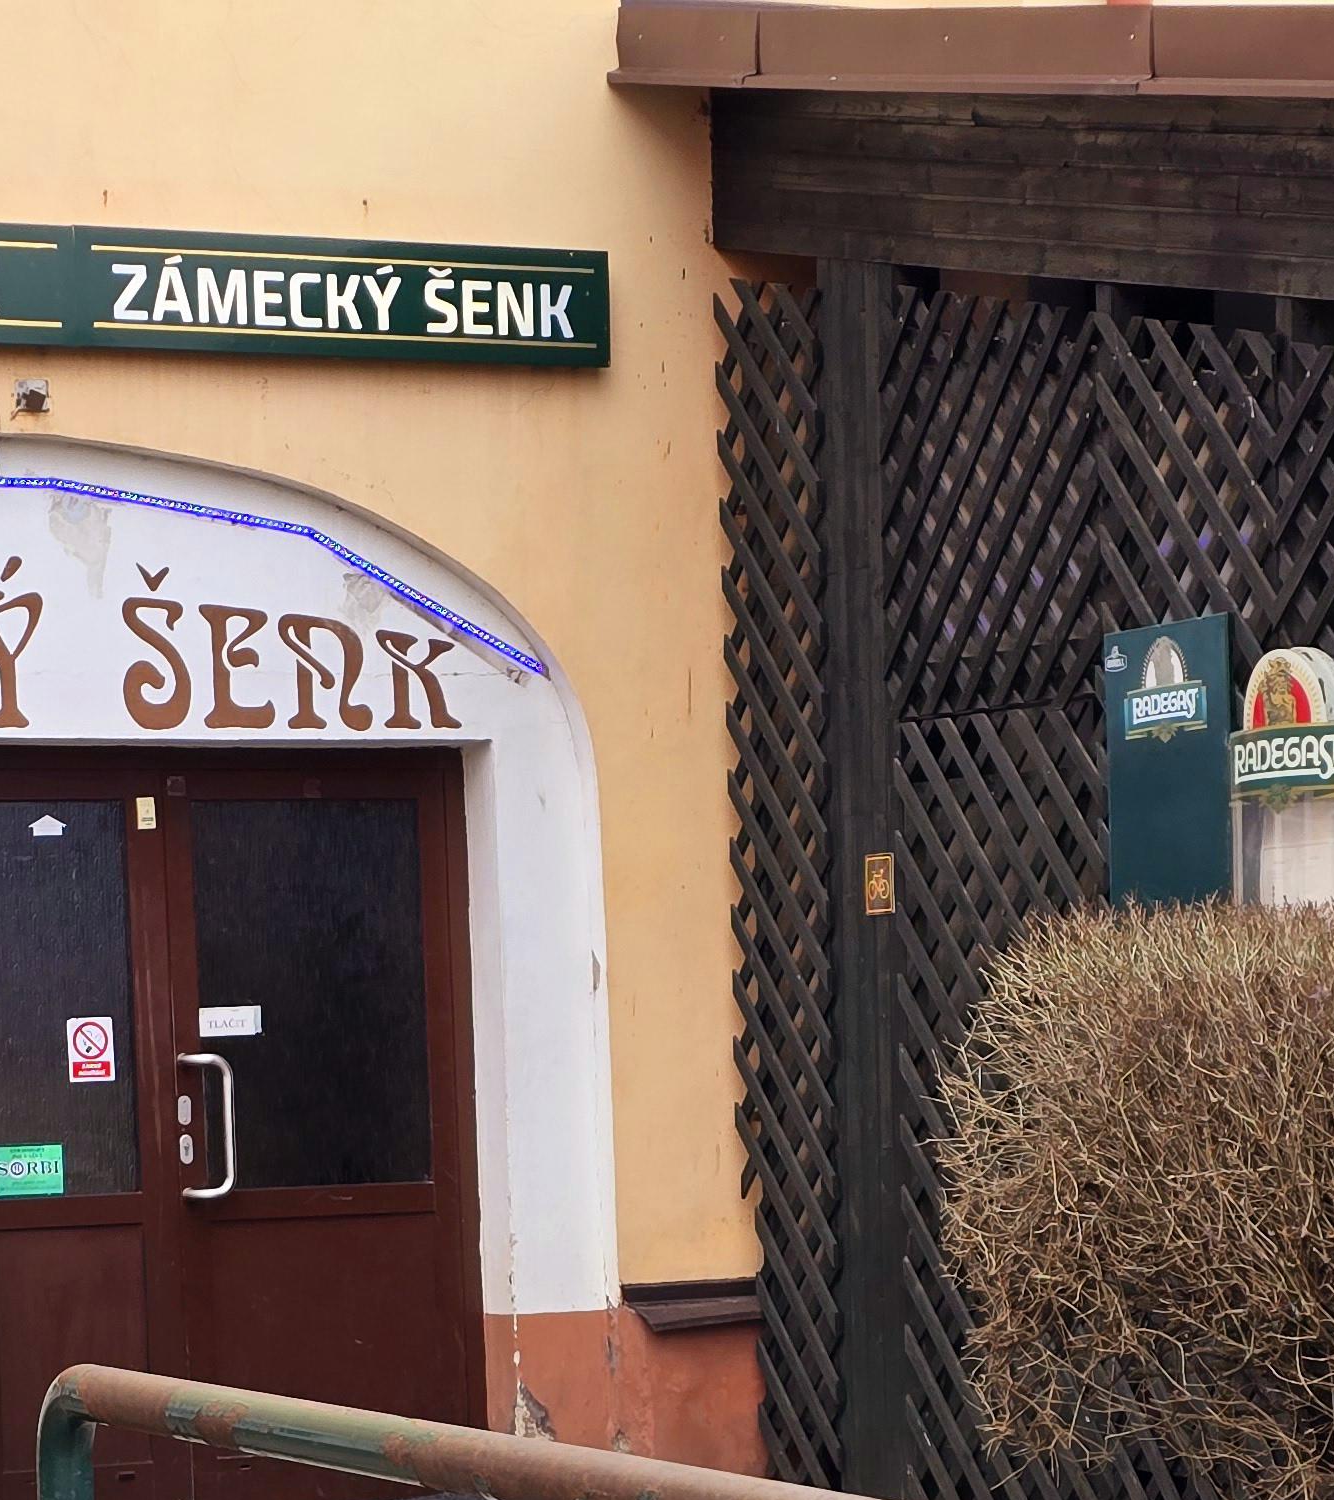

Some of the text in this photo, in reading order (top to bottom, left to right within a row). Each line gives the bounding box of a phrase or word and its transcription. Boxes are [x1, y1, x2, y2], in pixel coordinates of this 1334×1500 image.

[111, 254, 575, 339] ZÁMECKÝ ŠENK
[121, 562, 463, 731] ŠENK
[1132, 687, 1199, 725] RADEGAST
